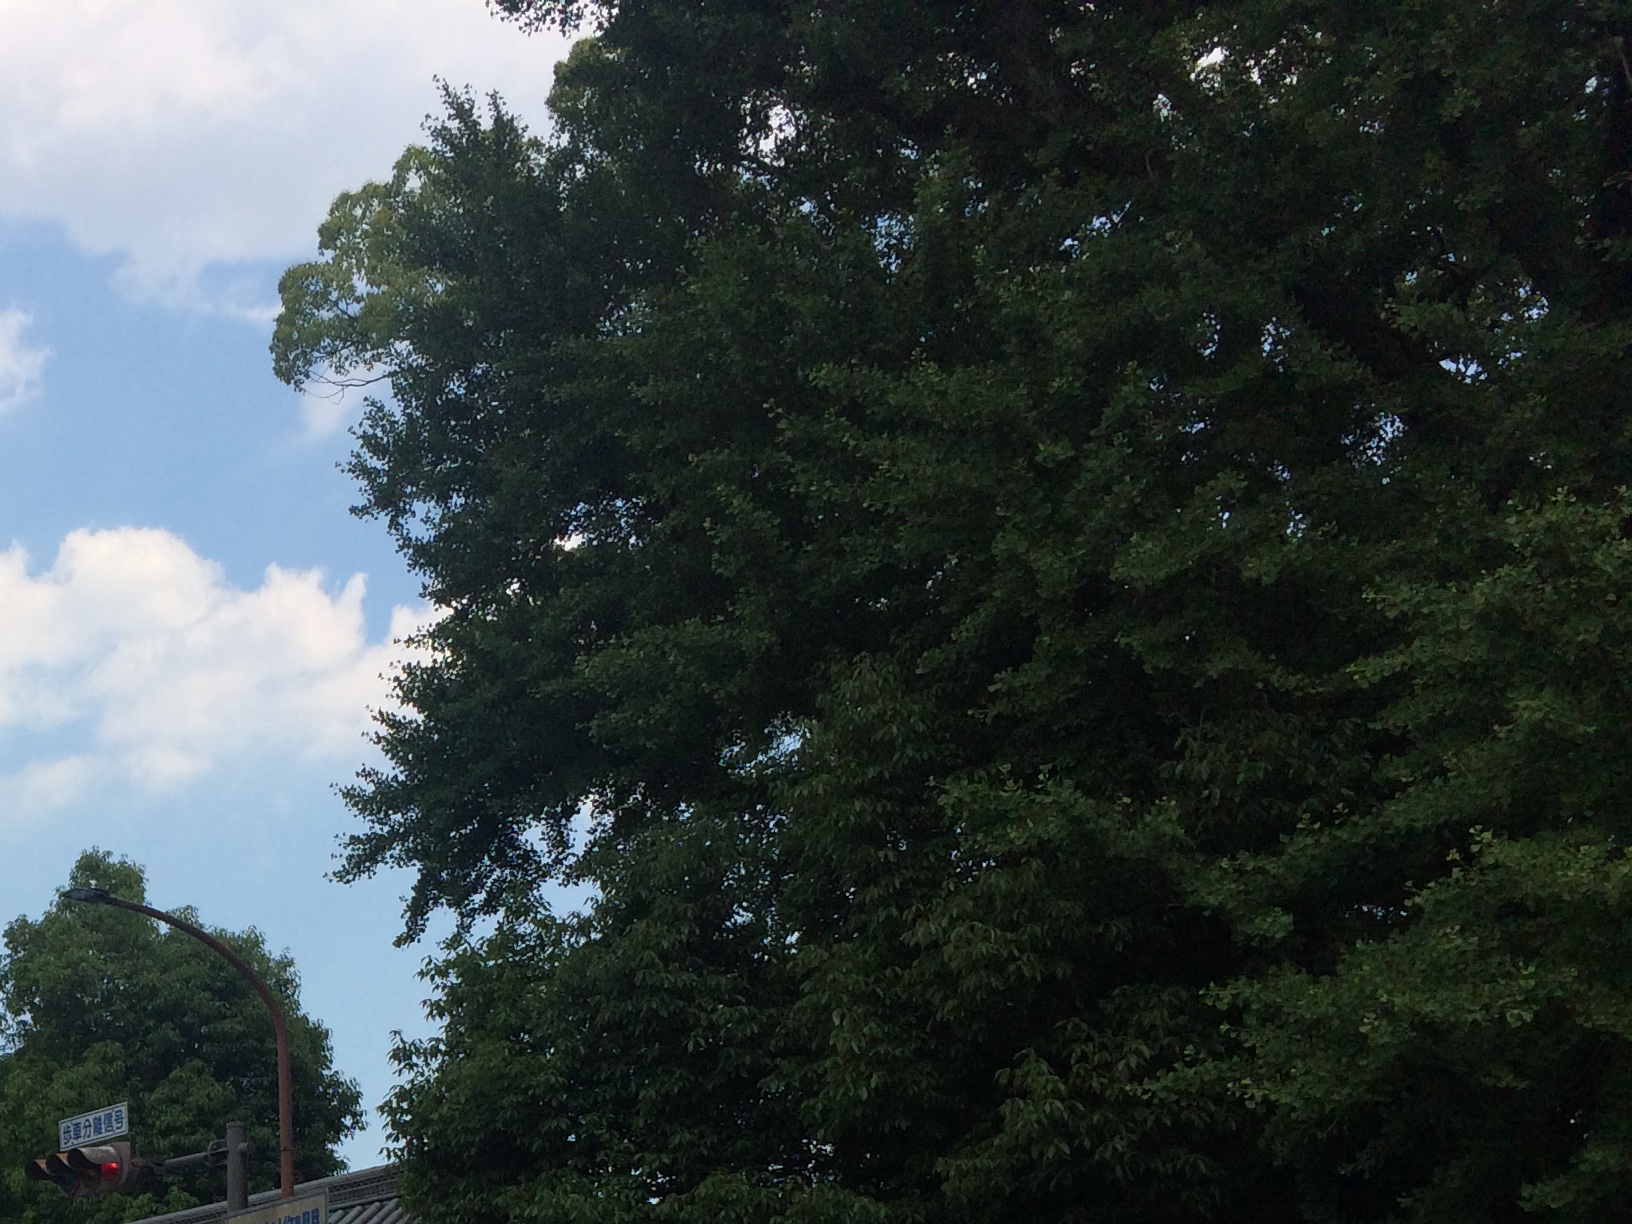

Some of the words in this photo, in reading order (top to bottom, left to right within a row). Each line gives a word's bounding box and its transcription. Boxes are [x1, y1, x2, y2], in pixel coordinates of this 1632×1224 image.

[63, 1109, 124, 1145] 歩車分離信号
